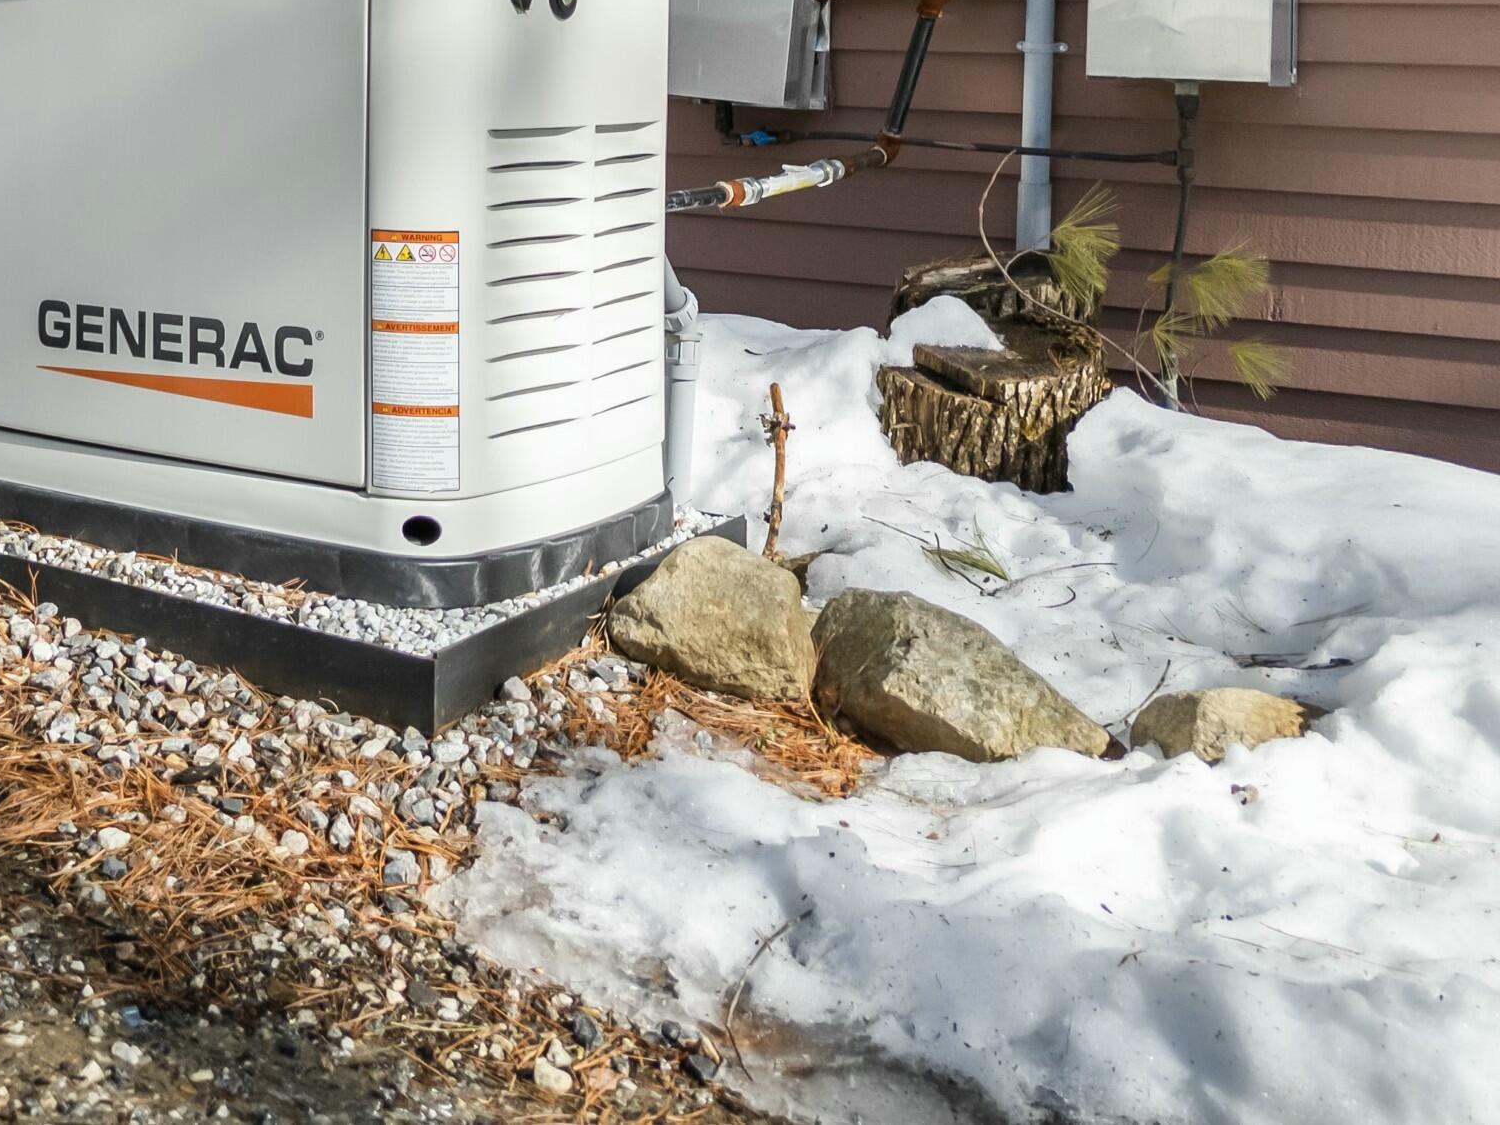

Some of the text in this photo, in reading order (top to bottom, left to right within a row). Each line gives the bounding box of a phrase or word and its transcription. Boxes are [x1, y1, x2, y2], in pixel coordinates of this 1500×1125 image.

[401, 234, 443, 242] WARNING
[384, 323, 456, 332] AVERTISSEMENT
[37, 299, 314, 377] GENERAC
[391, 406, 453, 415] ADVERTENCIA
